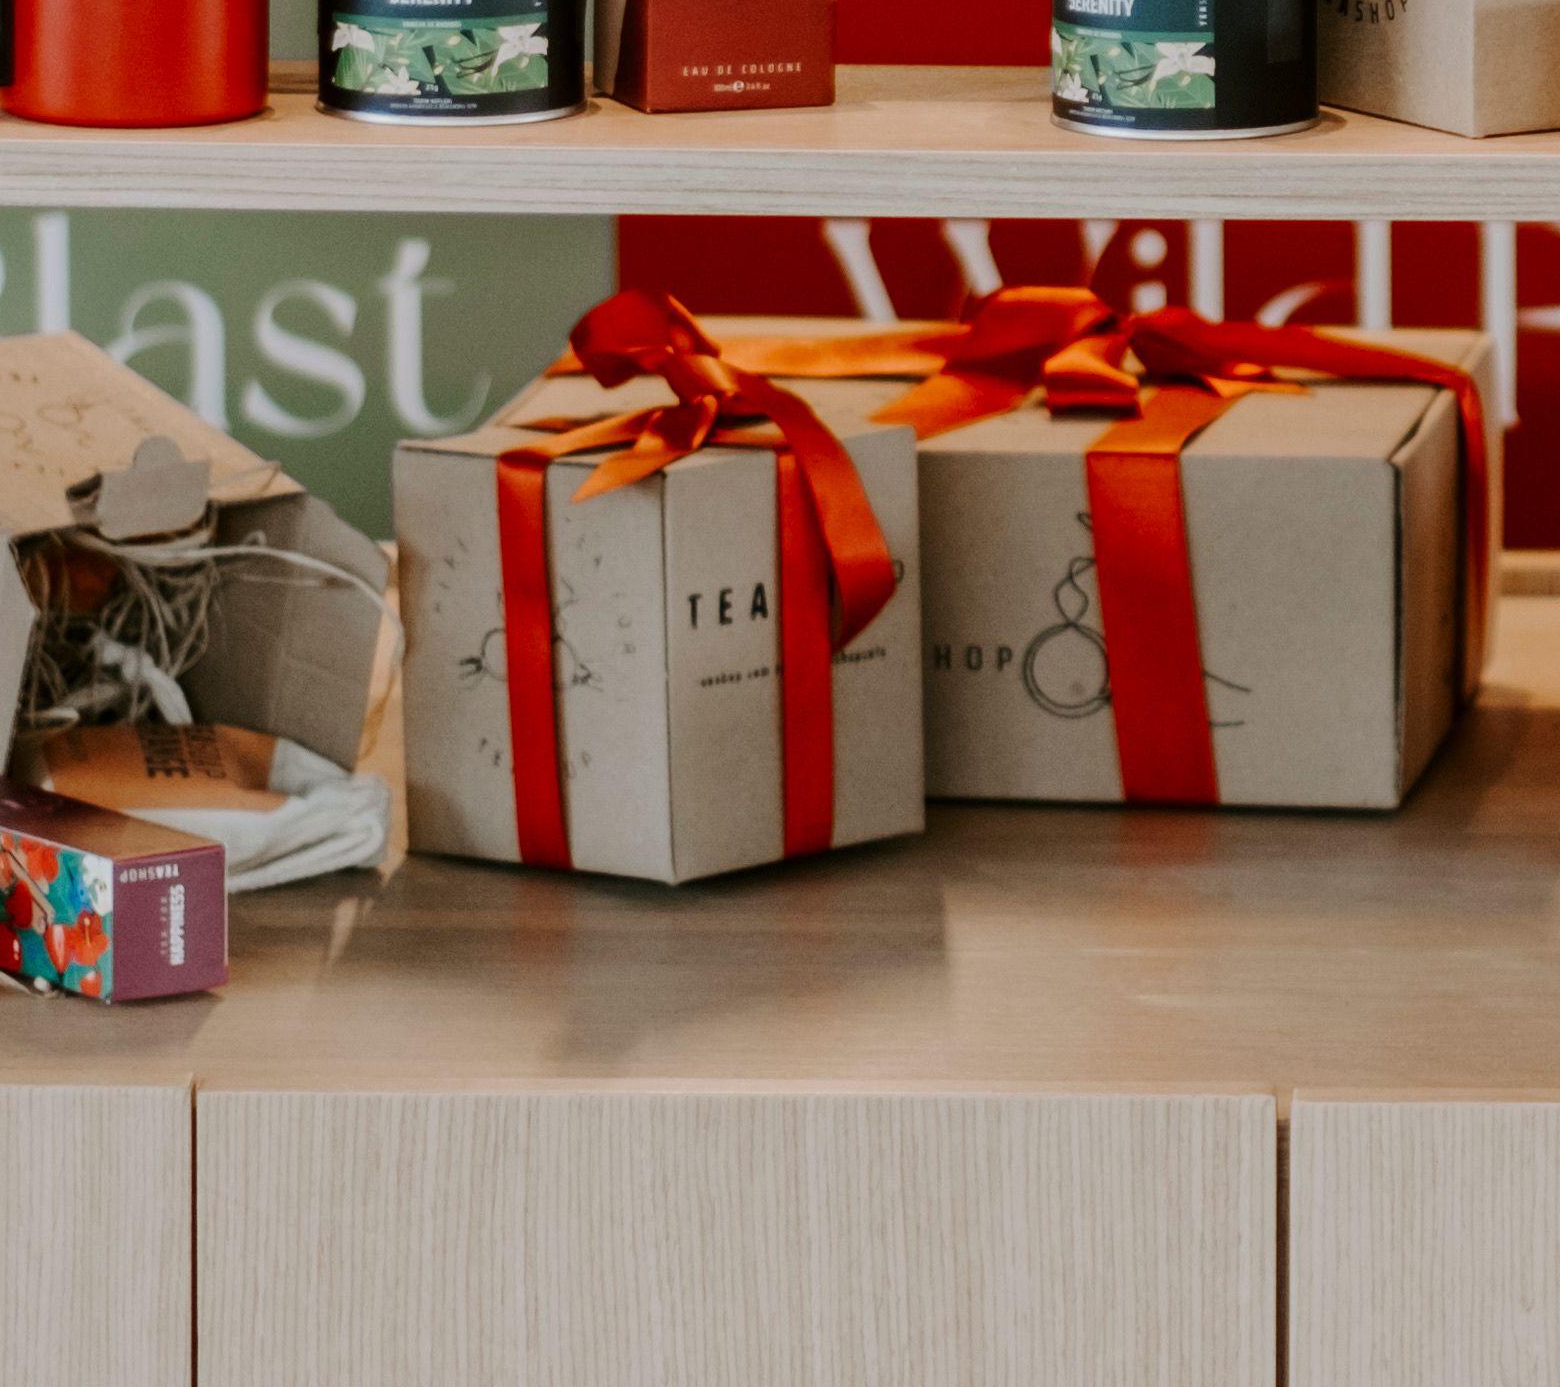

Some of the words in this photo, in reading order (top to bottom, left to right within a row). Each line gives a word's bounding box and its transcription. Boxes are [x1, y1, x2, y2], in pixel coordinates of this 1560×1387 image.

[741, 61, 802, 75] COLOGNE
[118, 863, 180, 882] TEASHOP
[168, 883, 186, 967] HAPPINESS
